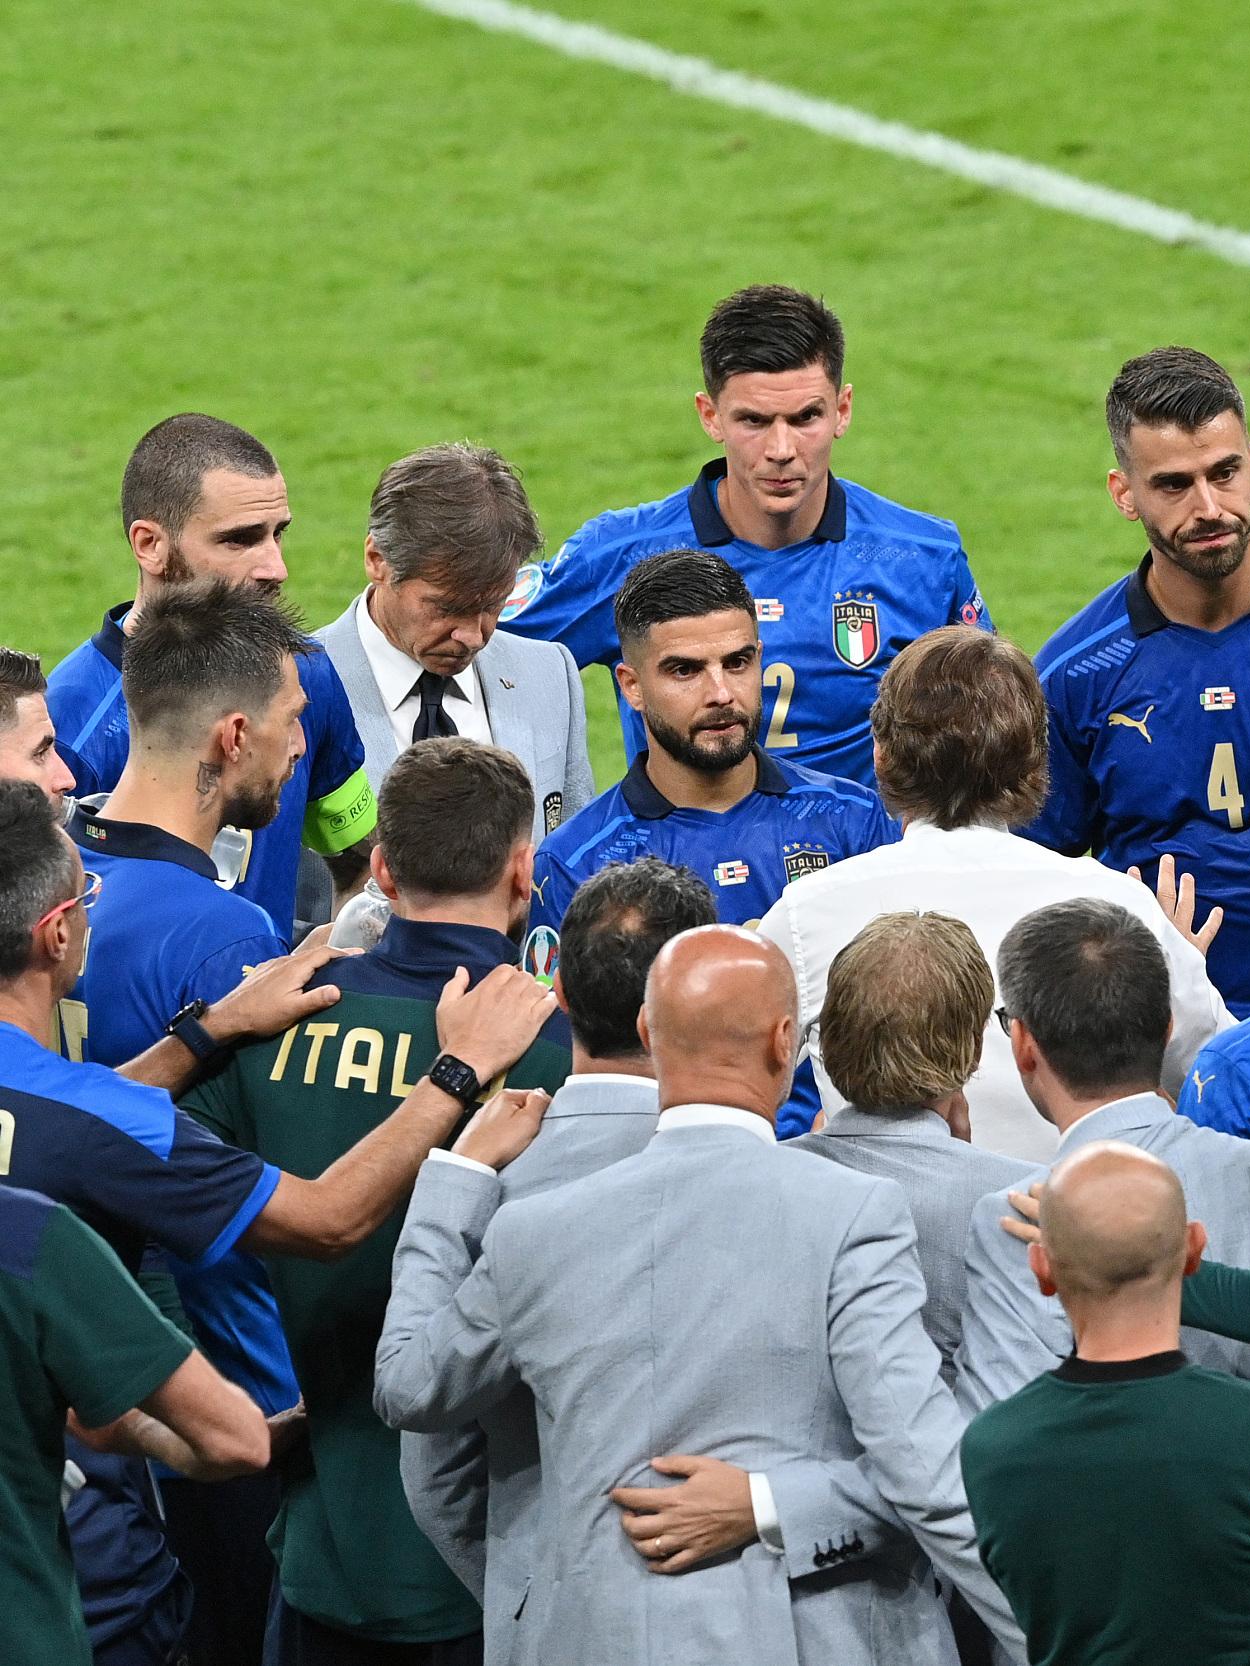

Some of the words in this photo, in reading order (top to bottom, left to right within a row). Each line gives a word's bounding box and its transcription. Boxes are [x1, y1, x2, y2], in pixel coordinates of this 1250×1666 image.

[836, 606, 873, 618] ITALIA
[1207, 743, 1245, 828] 4
[86, 824, 107, 837] ITALIA
[787, 857, 825, 871] ITALIA
